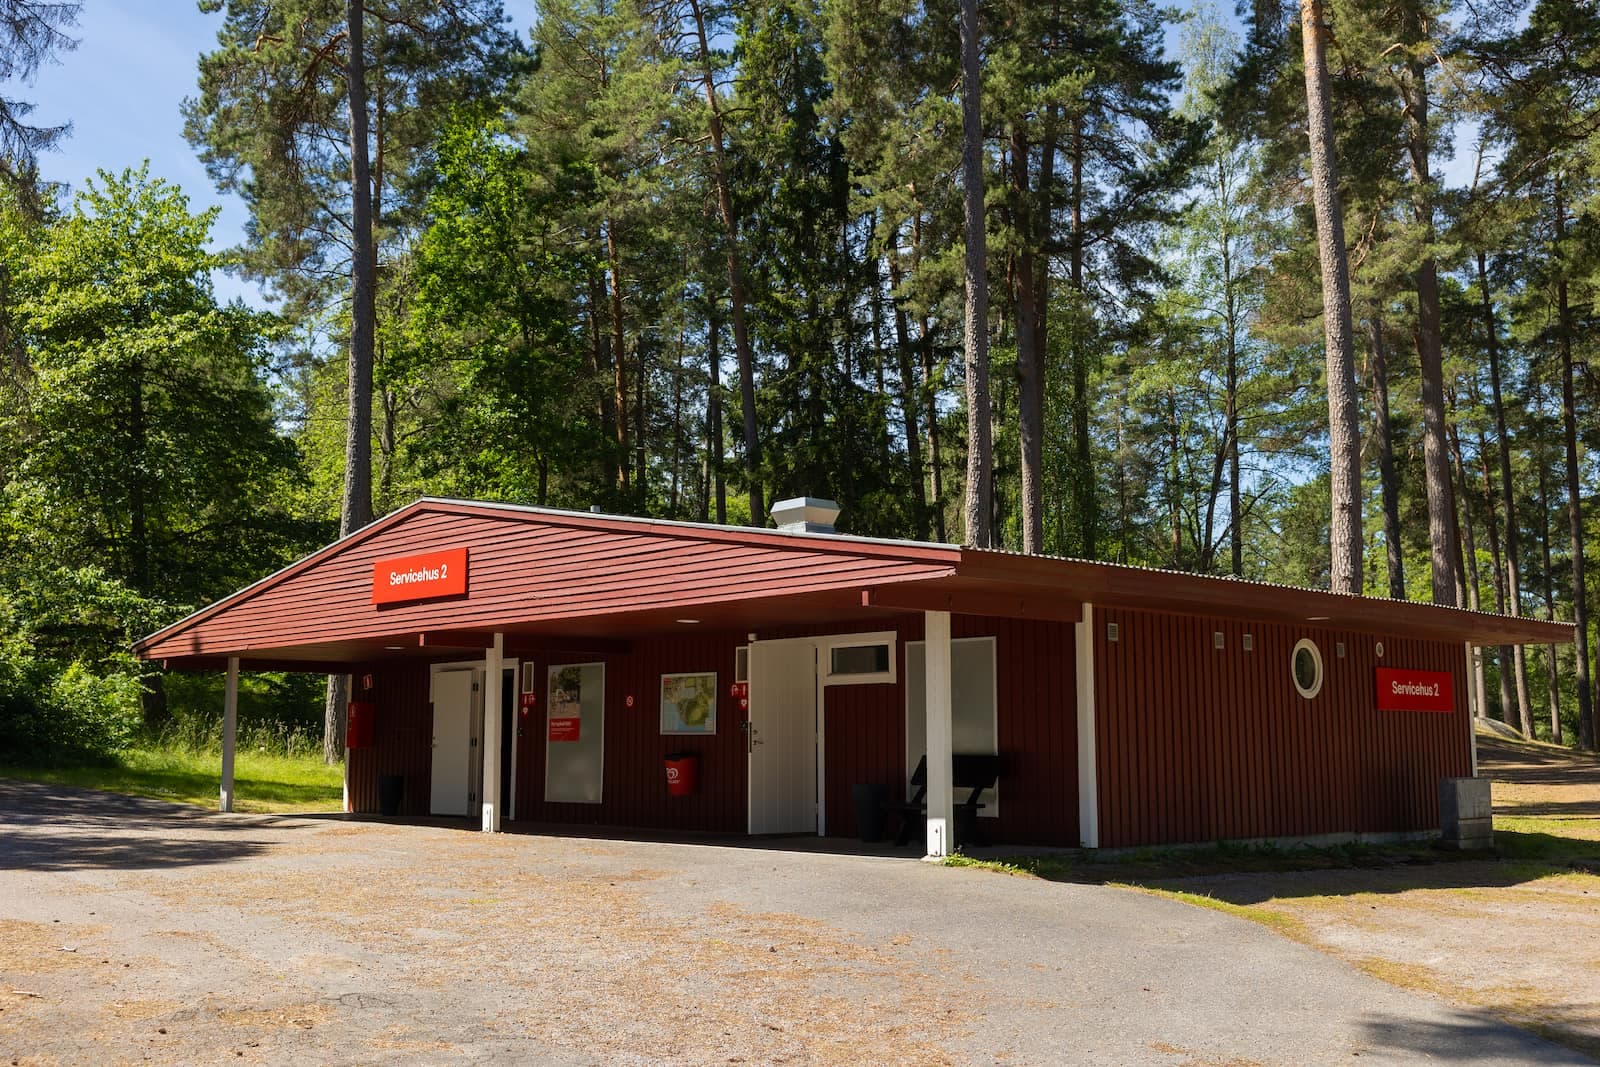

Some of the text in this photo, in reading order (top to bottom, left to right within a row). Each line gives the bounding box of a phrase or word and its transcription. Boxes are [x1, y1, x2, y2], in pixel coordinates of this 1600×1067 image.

[390, 564, 448, 586] Servicehus 2
[1392, 680, 1440, 697] Servicehus 2
